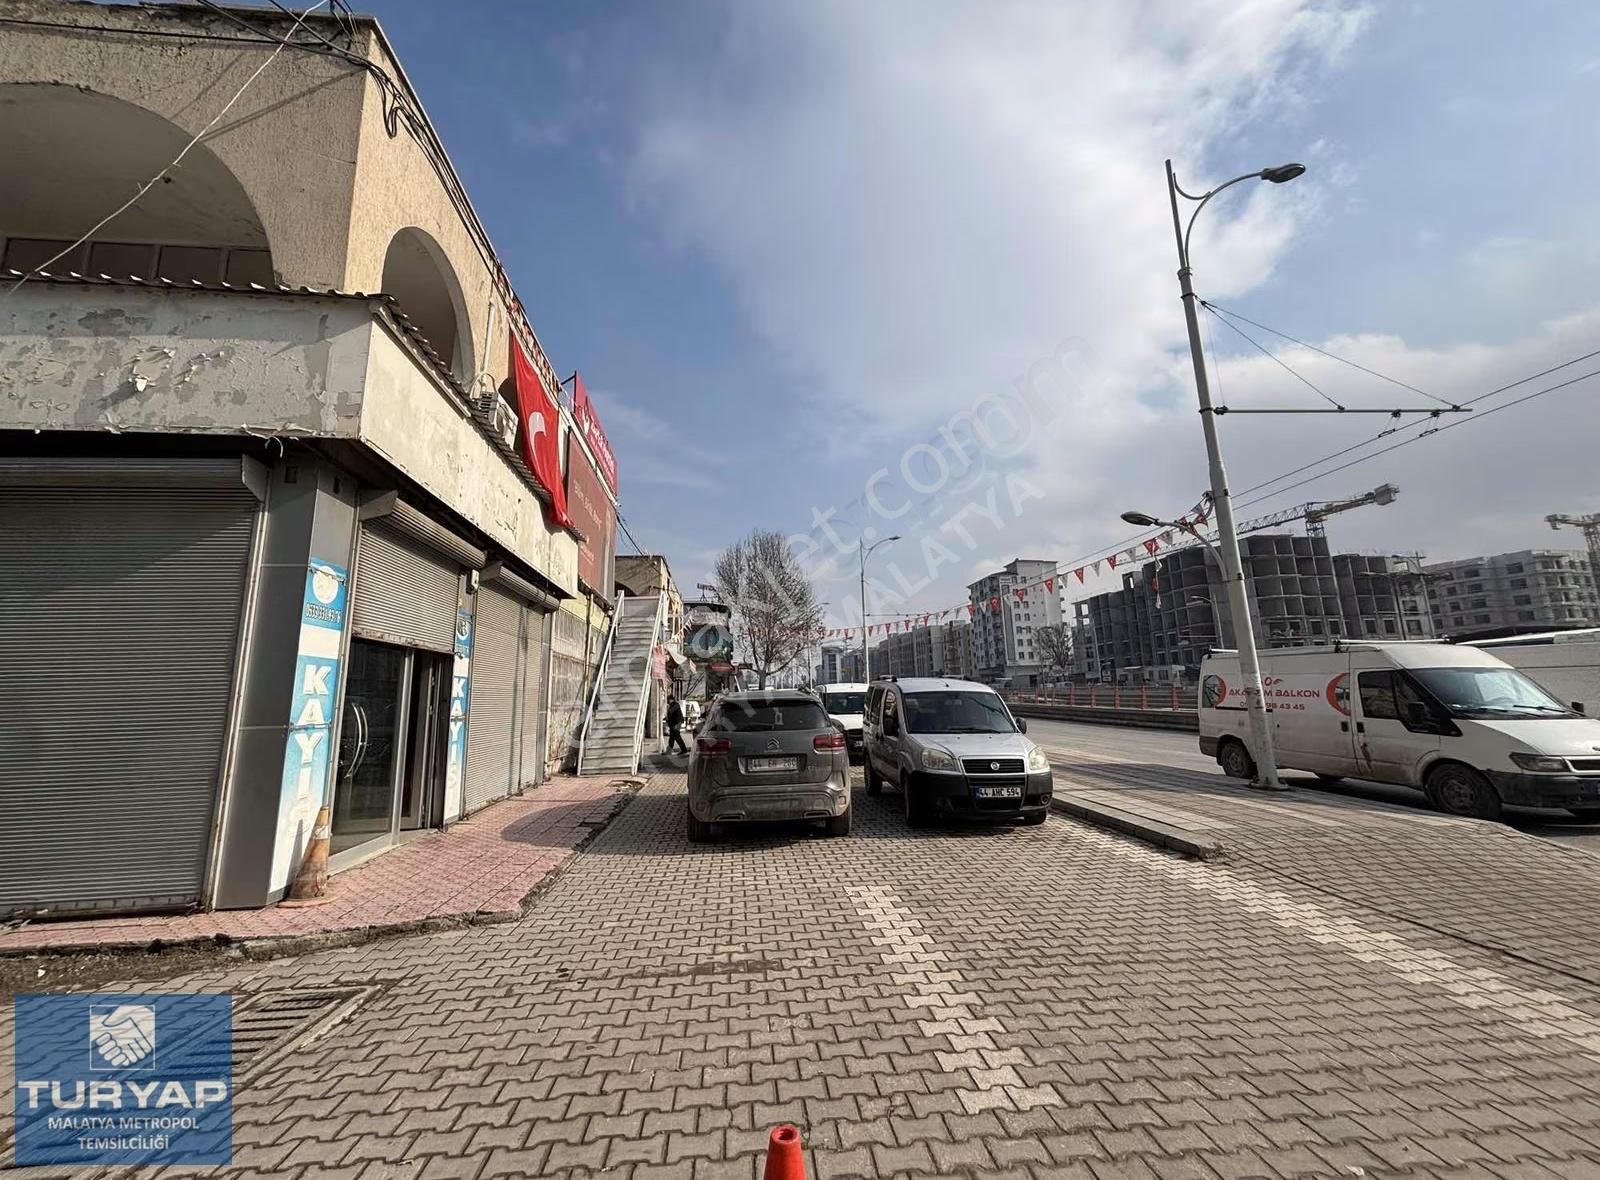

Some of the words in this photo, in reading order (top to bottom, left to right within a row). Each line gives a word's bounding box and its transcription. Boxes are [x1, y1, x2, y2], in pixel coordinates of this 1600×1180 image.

[1275, 689, 1320, 698] BALKON
[1279, 702, 1291, 710] 43
[1293, 703, 1305, 711] 45
